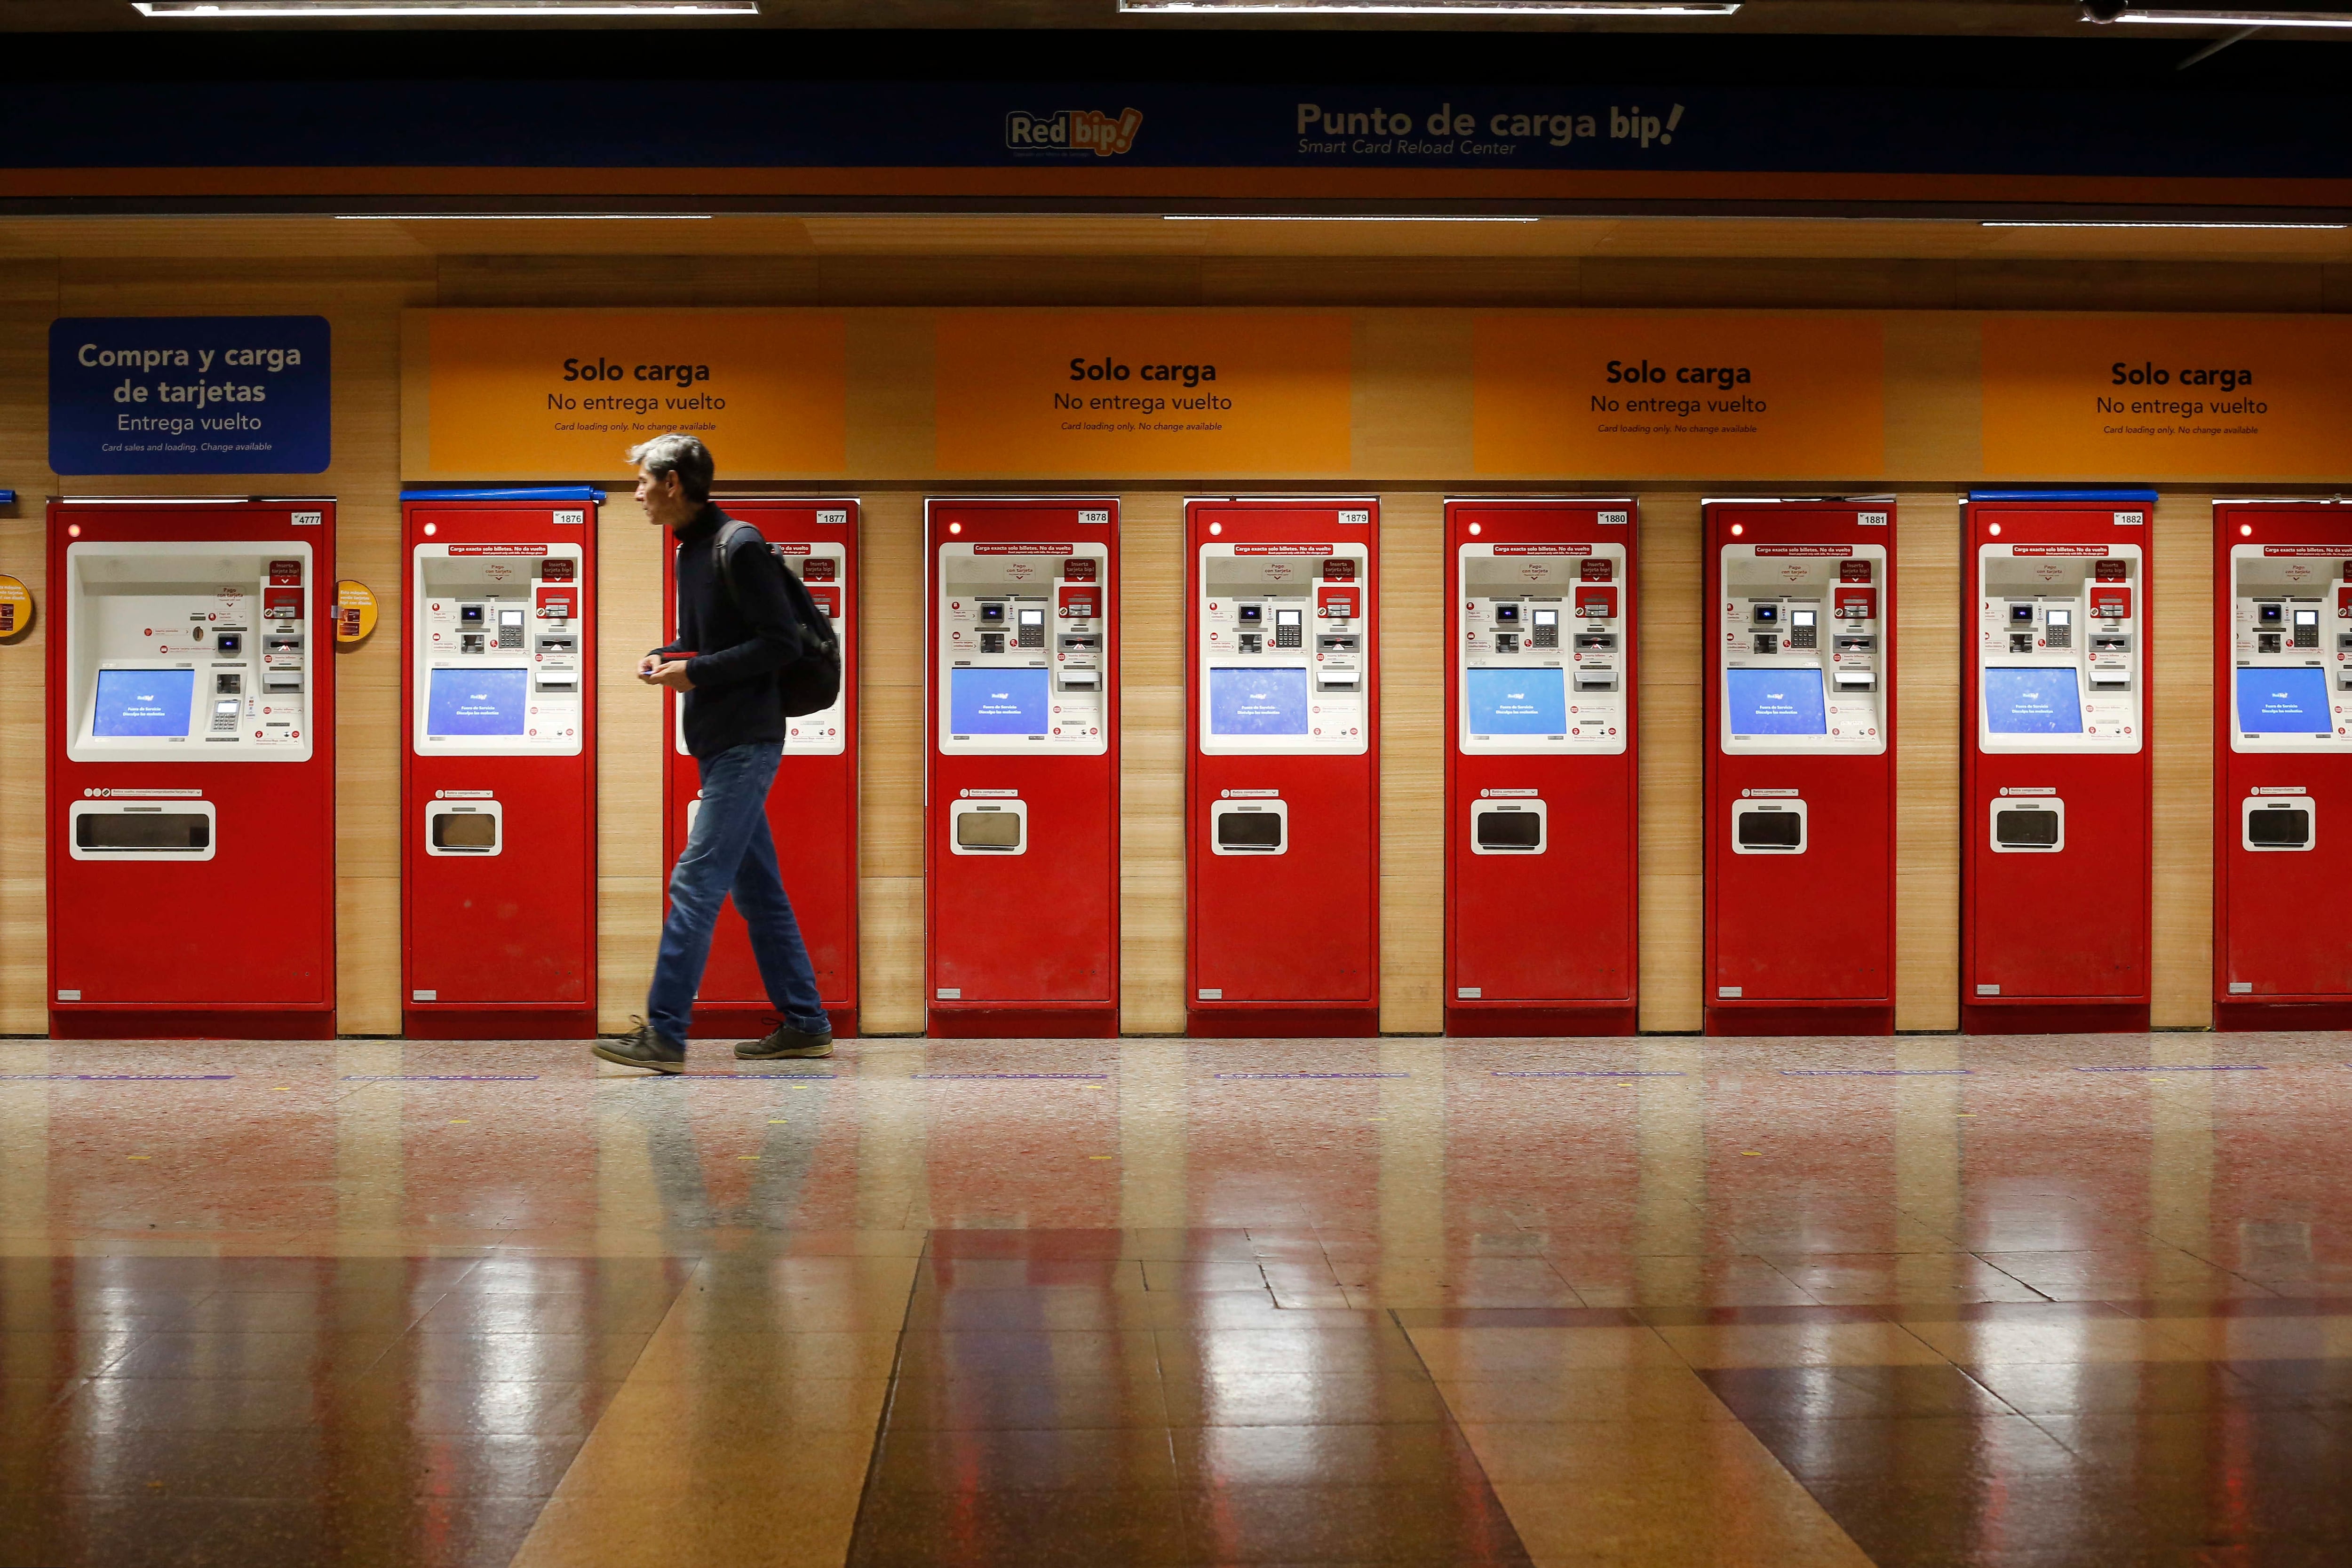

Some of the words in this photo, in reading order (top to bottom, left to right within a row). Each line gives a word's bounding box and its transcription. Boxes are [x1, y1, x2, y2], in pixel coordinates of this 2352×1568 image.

[1297, 103, 1412, 136] Punto
[1426, 102, 1477, 136] de
[1490, 113, 1596, 146] carga
[1610, 103, 1685, 148] bip!
[1298, 139, 1346, 153] Smart
[1352, 139, 1392, 153] Card
[1397, 139, 1454, 154] Reload
[1460, 140, 1516, 155] Center
[78, 343, 189, 373] Compra
[198, 350, 215, 373] y
[224, 349, 301, 372] carga
[564, 357, 623, 382] Solo
[634, 365, 709, 388] carga
[1070, 357, 1130, 381] Solo
[1140, 365, 1216, 388] carga
[1606, 359, 1666, 383] Solo
[1676, 367, 1751, 390] carga
[2112, 361, 2170, 385] Solo
[2179, 369, 2252, 392] carga
[113, 379, 148, 403] de
[158, 379, 266, 409] tarjetas
[548, 393, 576, 410] No
[583, 396, 659, 415] entrega
[665, 392, 726, 410] vuelto
[1054, 392, 1083, 410] No
[1089, 395, 1165, 414] entrega
[1172, 392, 1232, 410] vuelto
[1591, 395, 1620, 412] No
[1626, 398, 1700, 417] entrega
[1707, 395, 1767, 413] vuelto
[2097, 397, 2124, 413] No
[2131, 399, 2203, 419] entrega
[2209, 396, 2268, 414] vuelto
[118, 414, 193, 435] Entrega
[200, 412, 262, 430] vuelto
[577, 422, 608, 432] loading
[610, 422, 629, 432] only.
[647, 422, 677, 432] change
[679, 422, 716, 430] available
[1083, 422, 1114, 432] loading
[1117, 422, 1136, 432] only.
[1153, 422, 1184, 432] change
[1620, 424, 1651, 434] loading
[1653, 424, 1672, 434] only.
[1689, 425, 1719, 435] change
[2125, 426, 2155, 436] loading
[2157, 426, 2175, 436] only.
[2193, 426, 2222, 436] change
[2223, 426, 2259, 434] available
[102, 443, 122, 452] Card
[165, 443, 198, 453] loading.
[201, 443, 233, 453] Change
[299, 516, 320, 524] 4777
